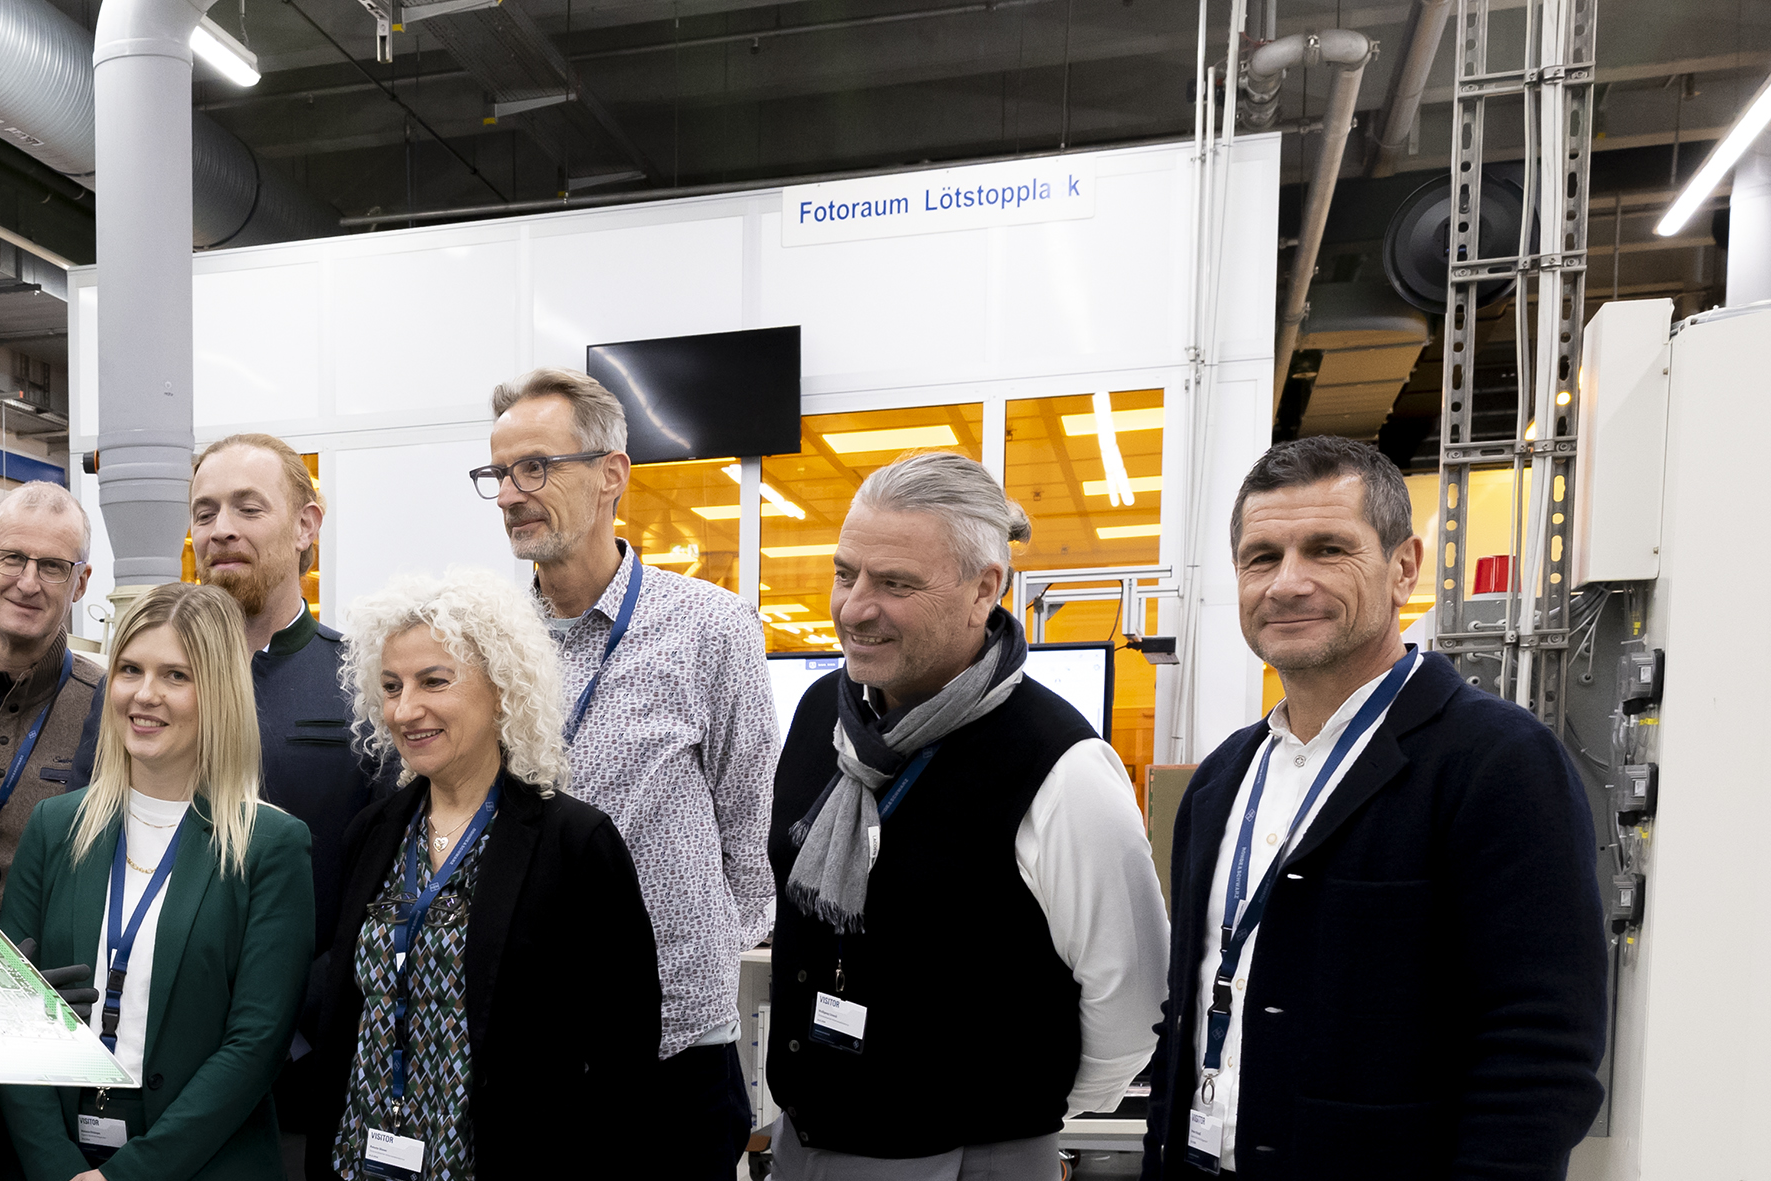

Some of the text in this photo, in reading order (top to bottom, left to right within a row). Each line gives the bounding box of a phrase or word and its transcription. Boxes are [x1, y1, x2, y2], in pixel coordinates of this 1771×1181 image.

[799, 174, 1081, 224] Fotoraum Lötstopplak
[819, 995, 841, 1009] VISITOR
[79, 1117, 100, 1126] VISITOR
[371, 1131, 394, 1144] VISITOR
